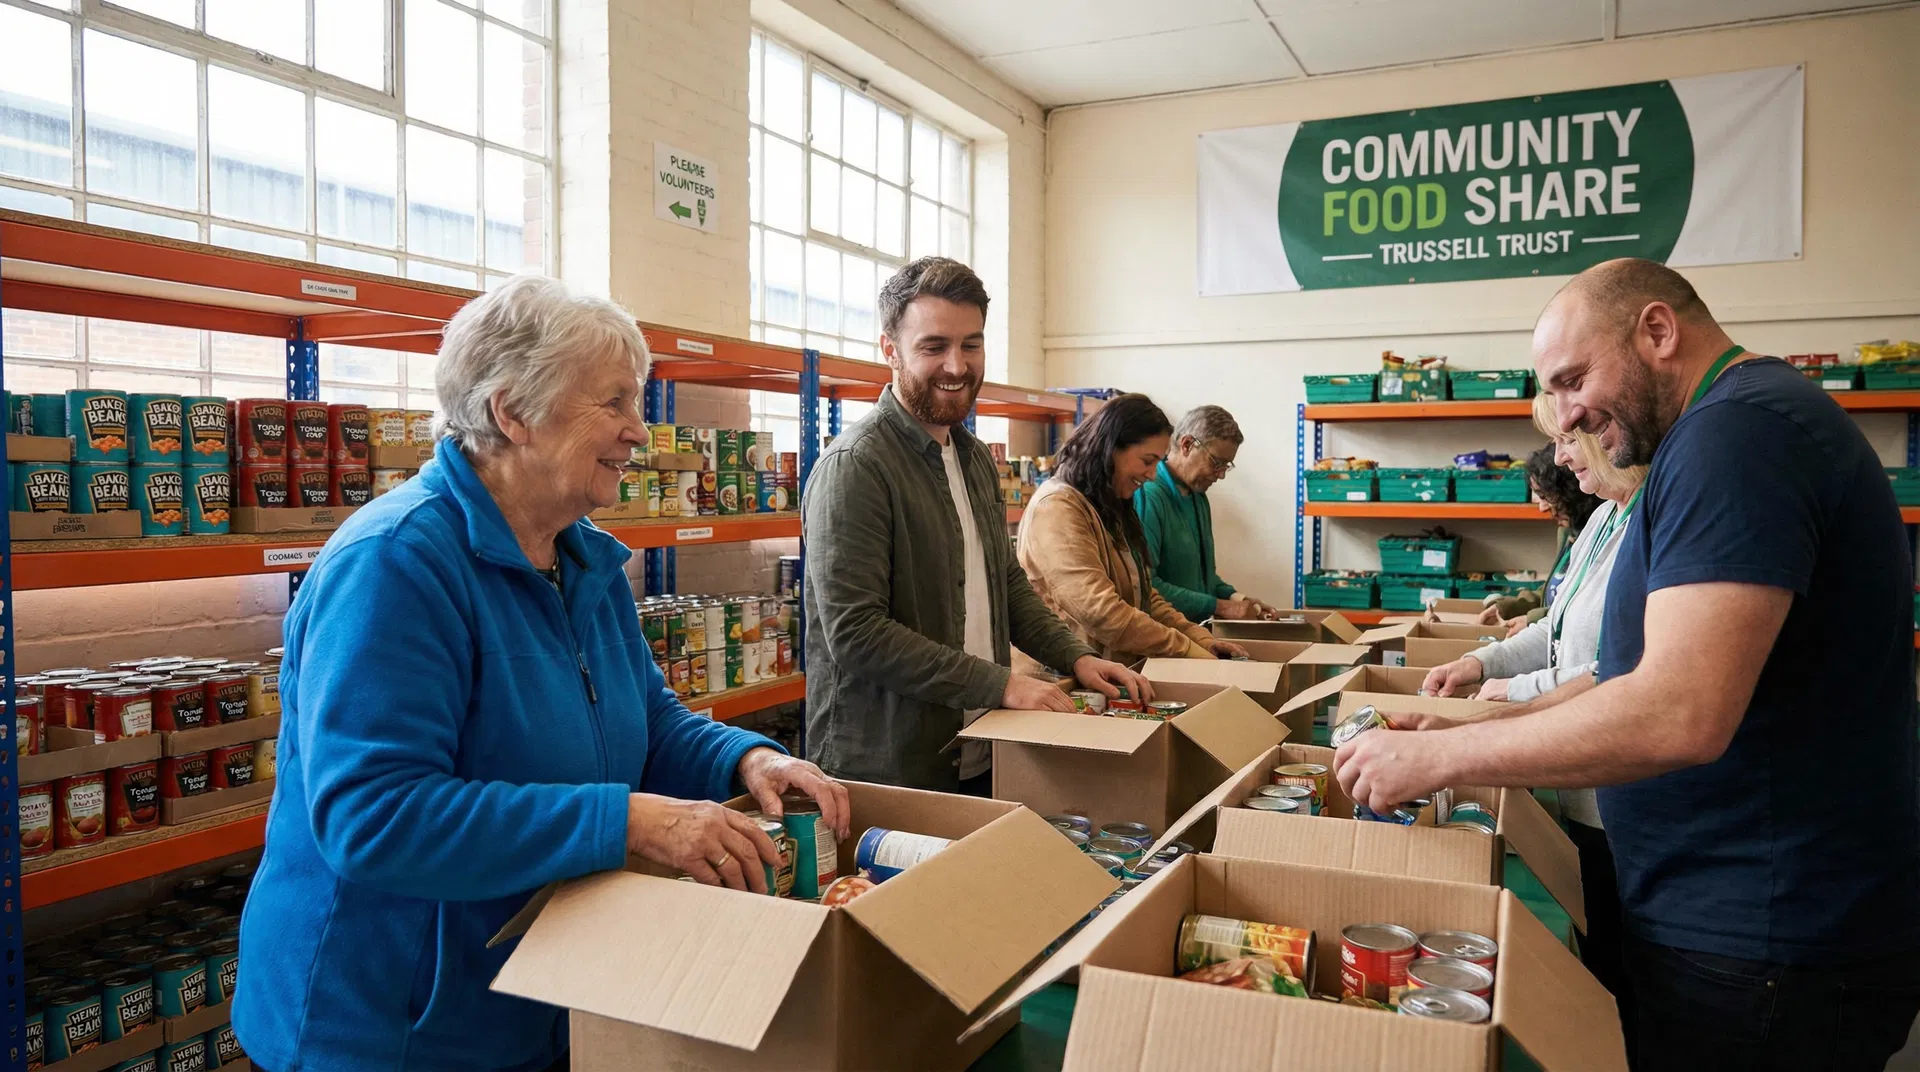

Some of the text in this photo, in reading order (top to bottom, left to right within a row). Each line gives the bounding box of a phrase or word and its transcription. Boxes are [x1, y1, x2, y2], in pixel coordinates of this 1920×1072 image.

[1322, 108, 1643, 184] COMMUNITY
[659, 170, 715, 200] VOLUNTEERS
[1323, 164, 1641, 237] FOOD SHARE
[1379, 230, 1574, 265] TRUSSELL TRUST
[87, 409, 127, 425] BEANS
[26, 1036, 43, 1053] ANS
